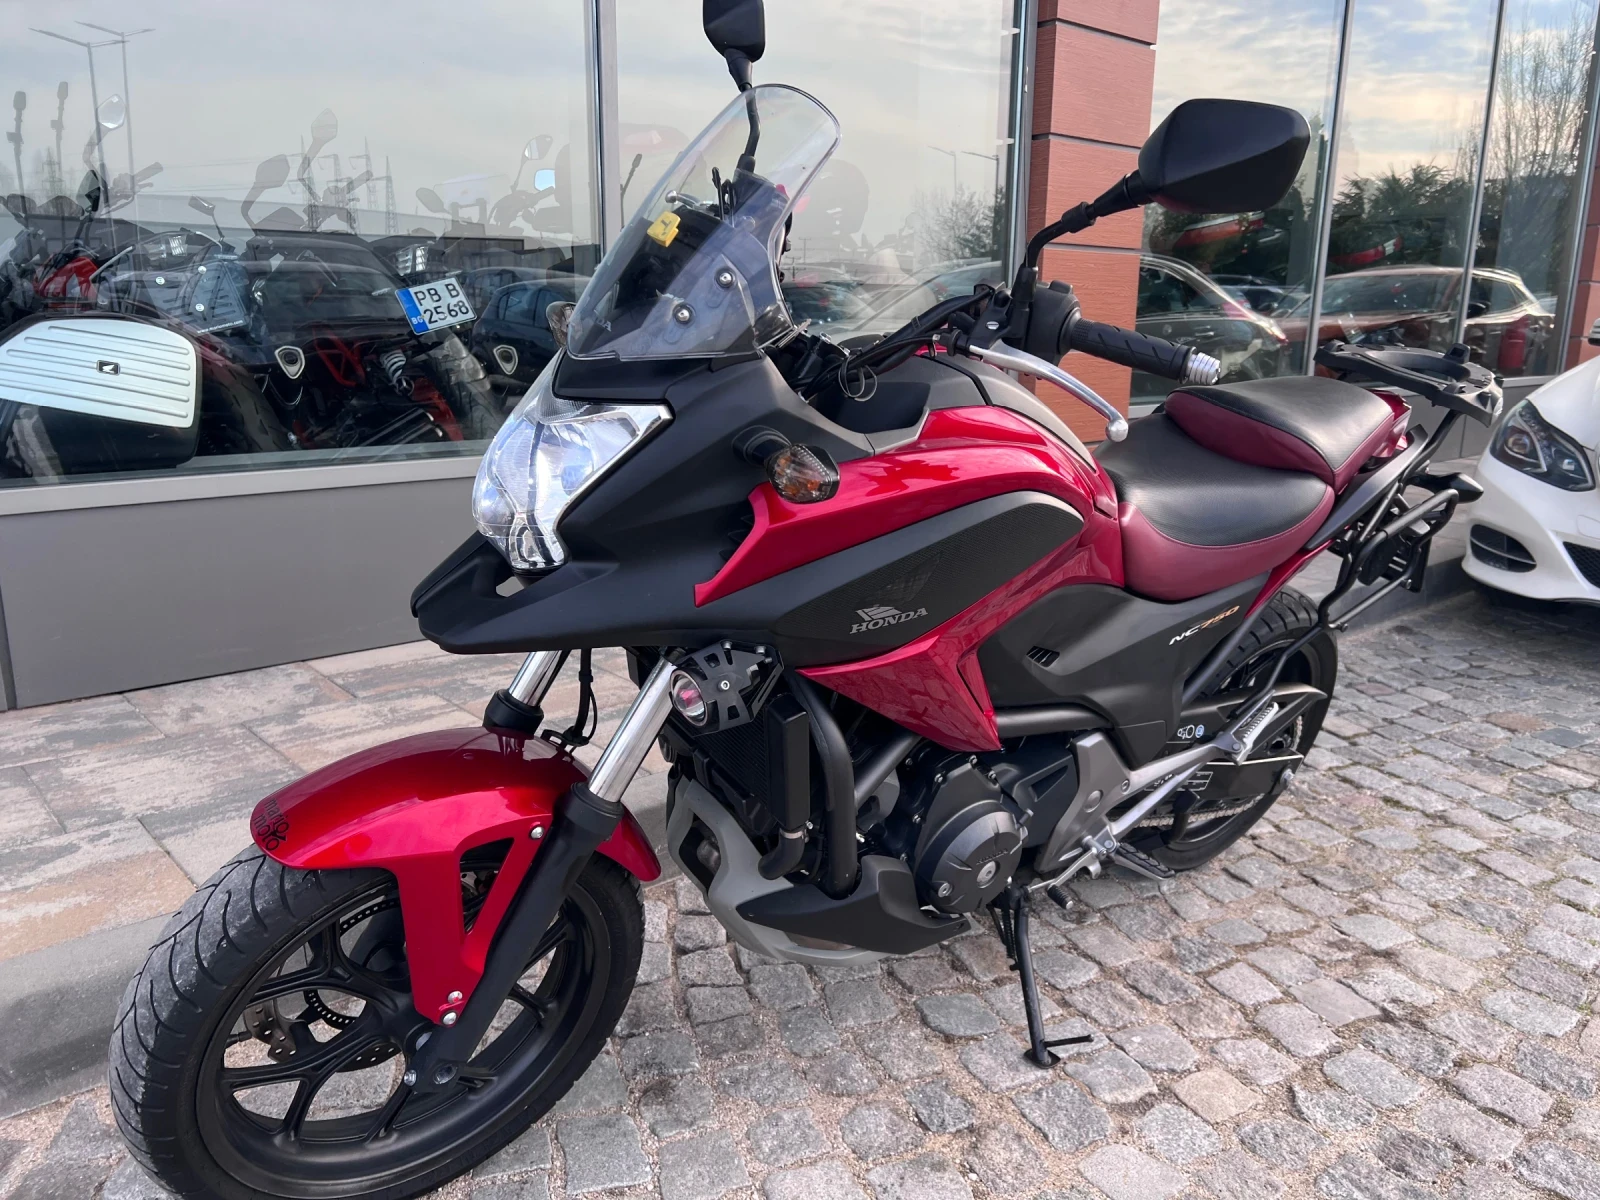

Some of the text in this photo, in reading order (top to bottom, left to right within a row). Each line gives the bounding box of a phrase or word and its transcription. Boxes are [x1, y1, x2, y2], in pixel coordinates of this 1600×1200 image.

[414, 282, 460, 306] PB B
[423, 300, 469, 324] 2568
[849, 607, 929, 634] HONDA
[1168, 605, 1240, 646] NC750
[264, 798, 289, 834] mario
[253, 813, 286, 851] moto
